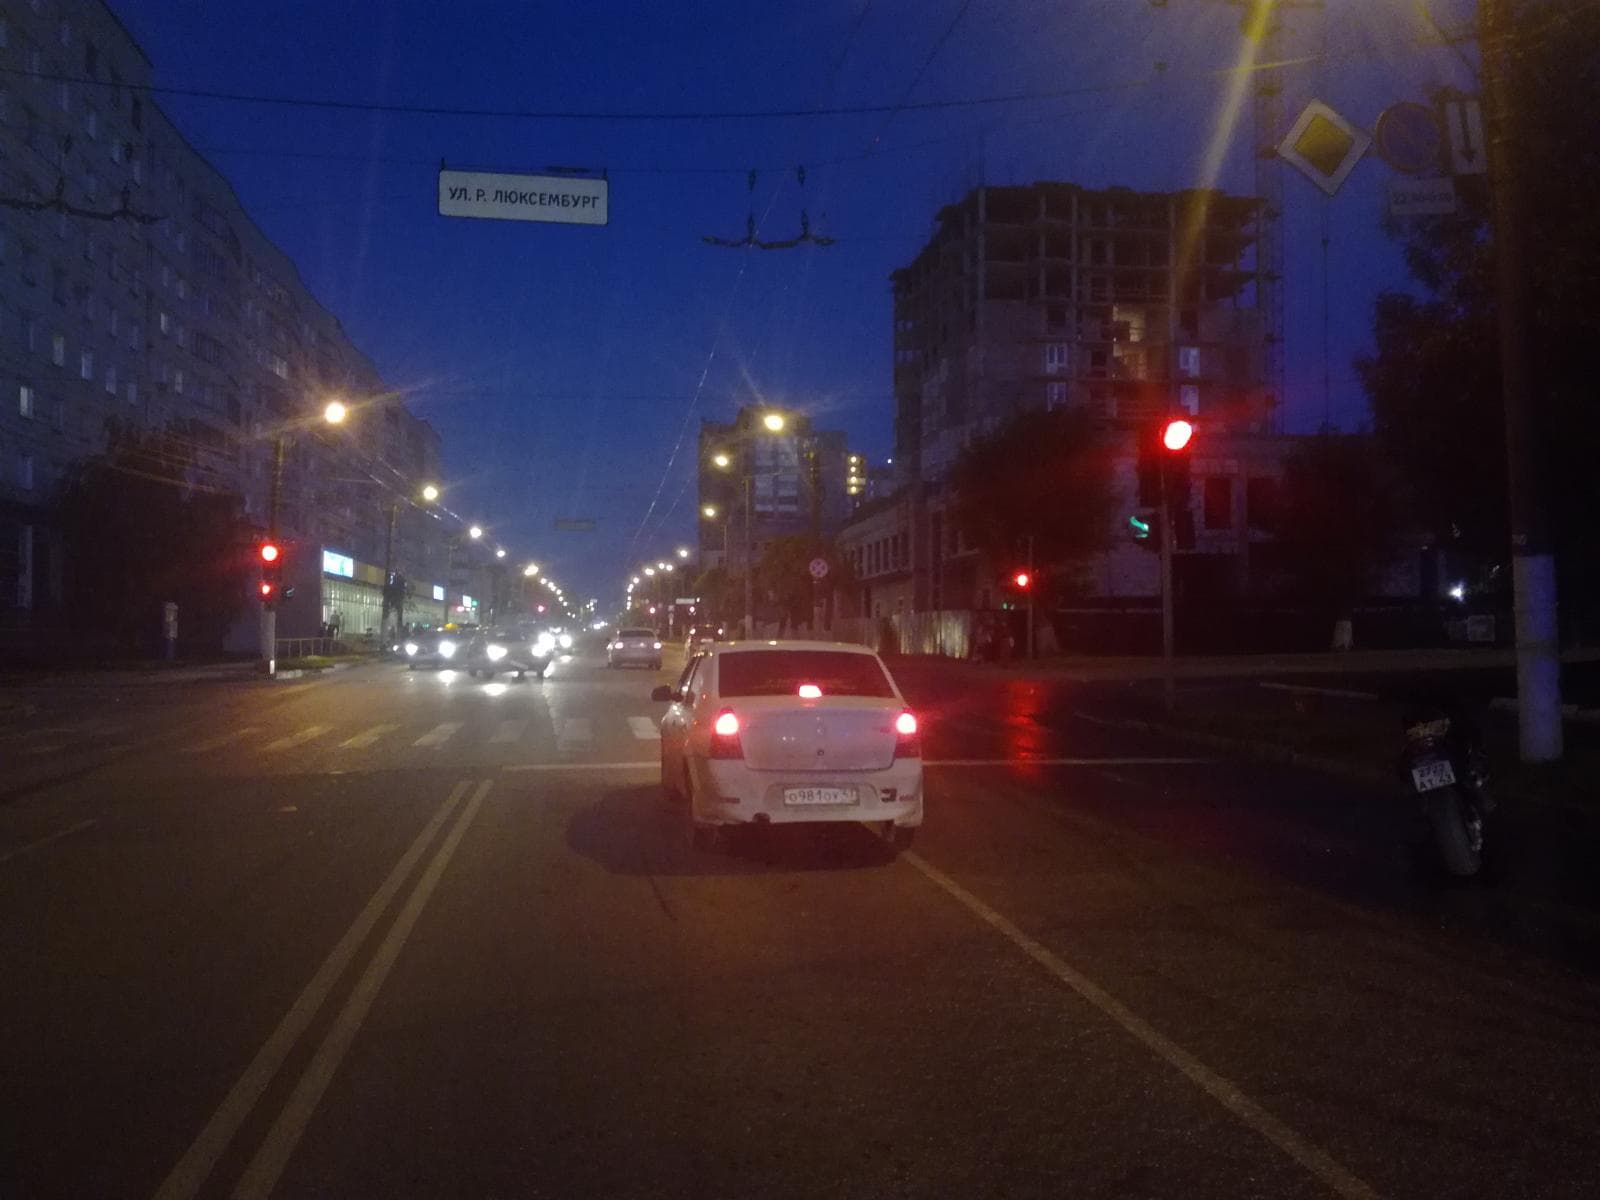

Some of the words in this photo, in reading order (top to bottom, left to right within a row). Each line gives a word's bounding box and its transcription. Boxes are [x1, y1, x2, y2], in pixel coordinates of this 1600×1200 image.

[449, 187, 471, 202] УЛ.
[476, 189, 487, 202] Р.
[492, 189, 599, 209] ЛЮКСЕМБУРГ
